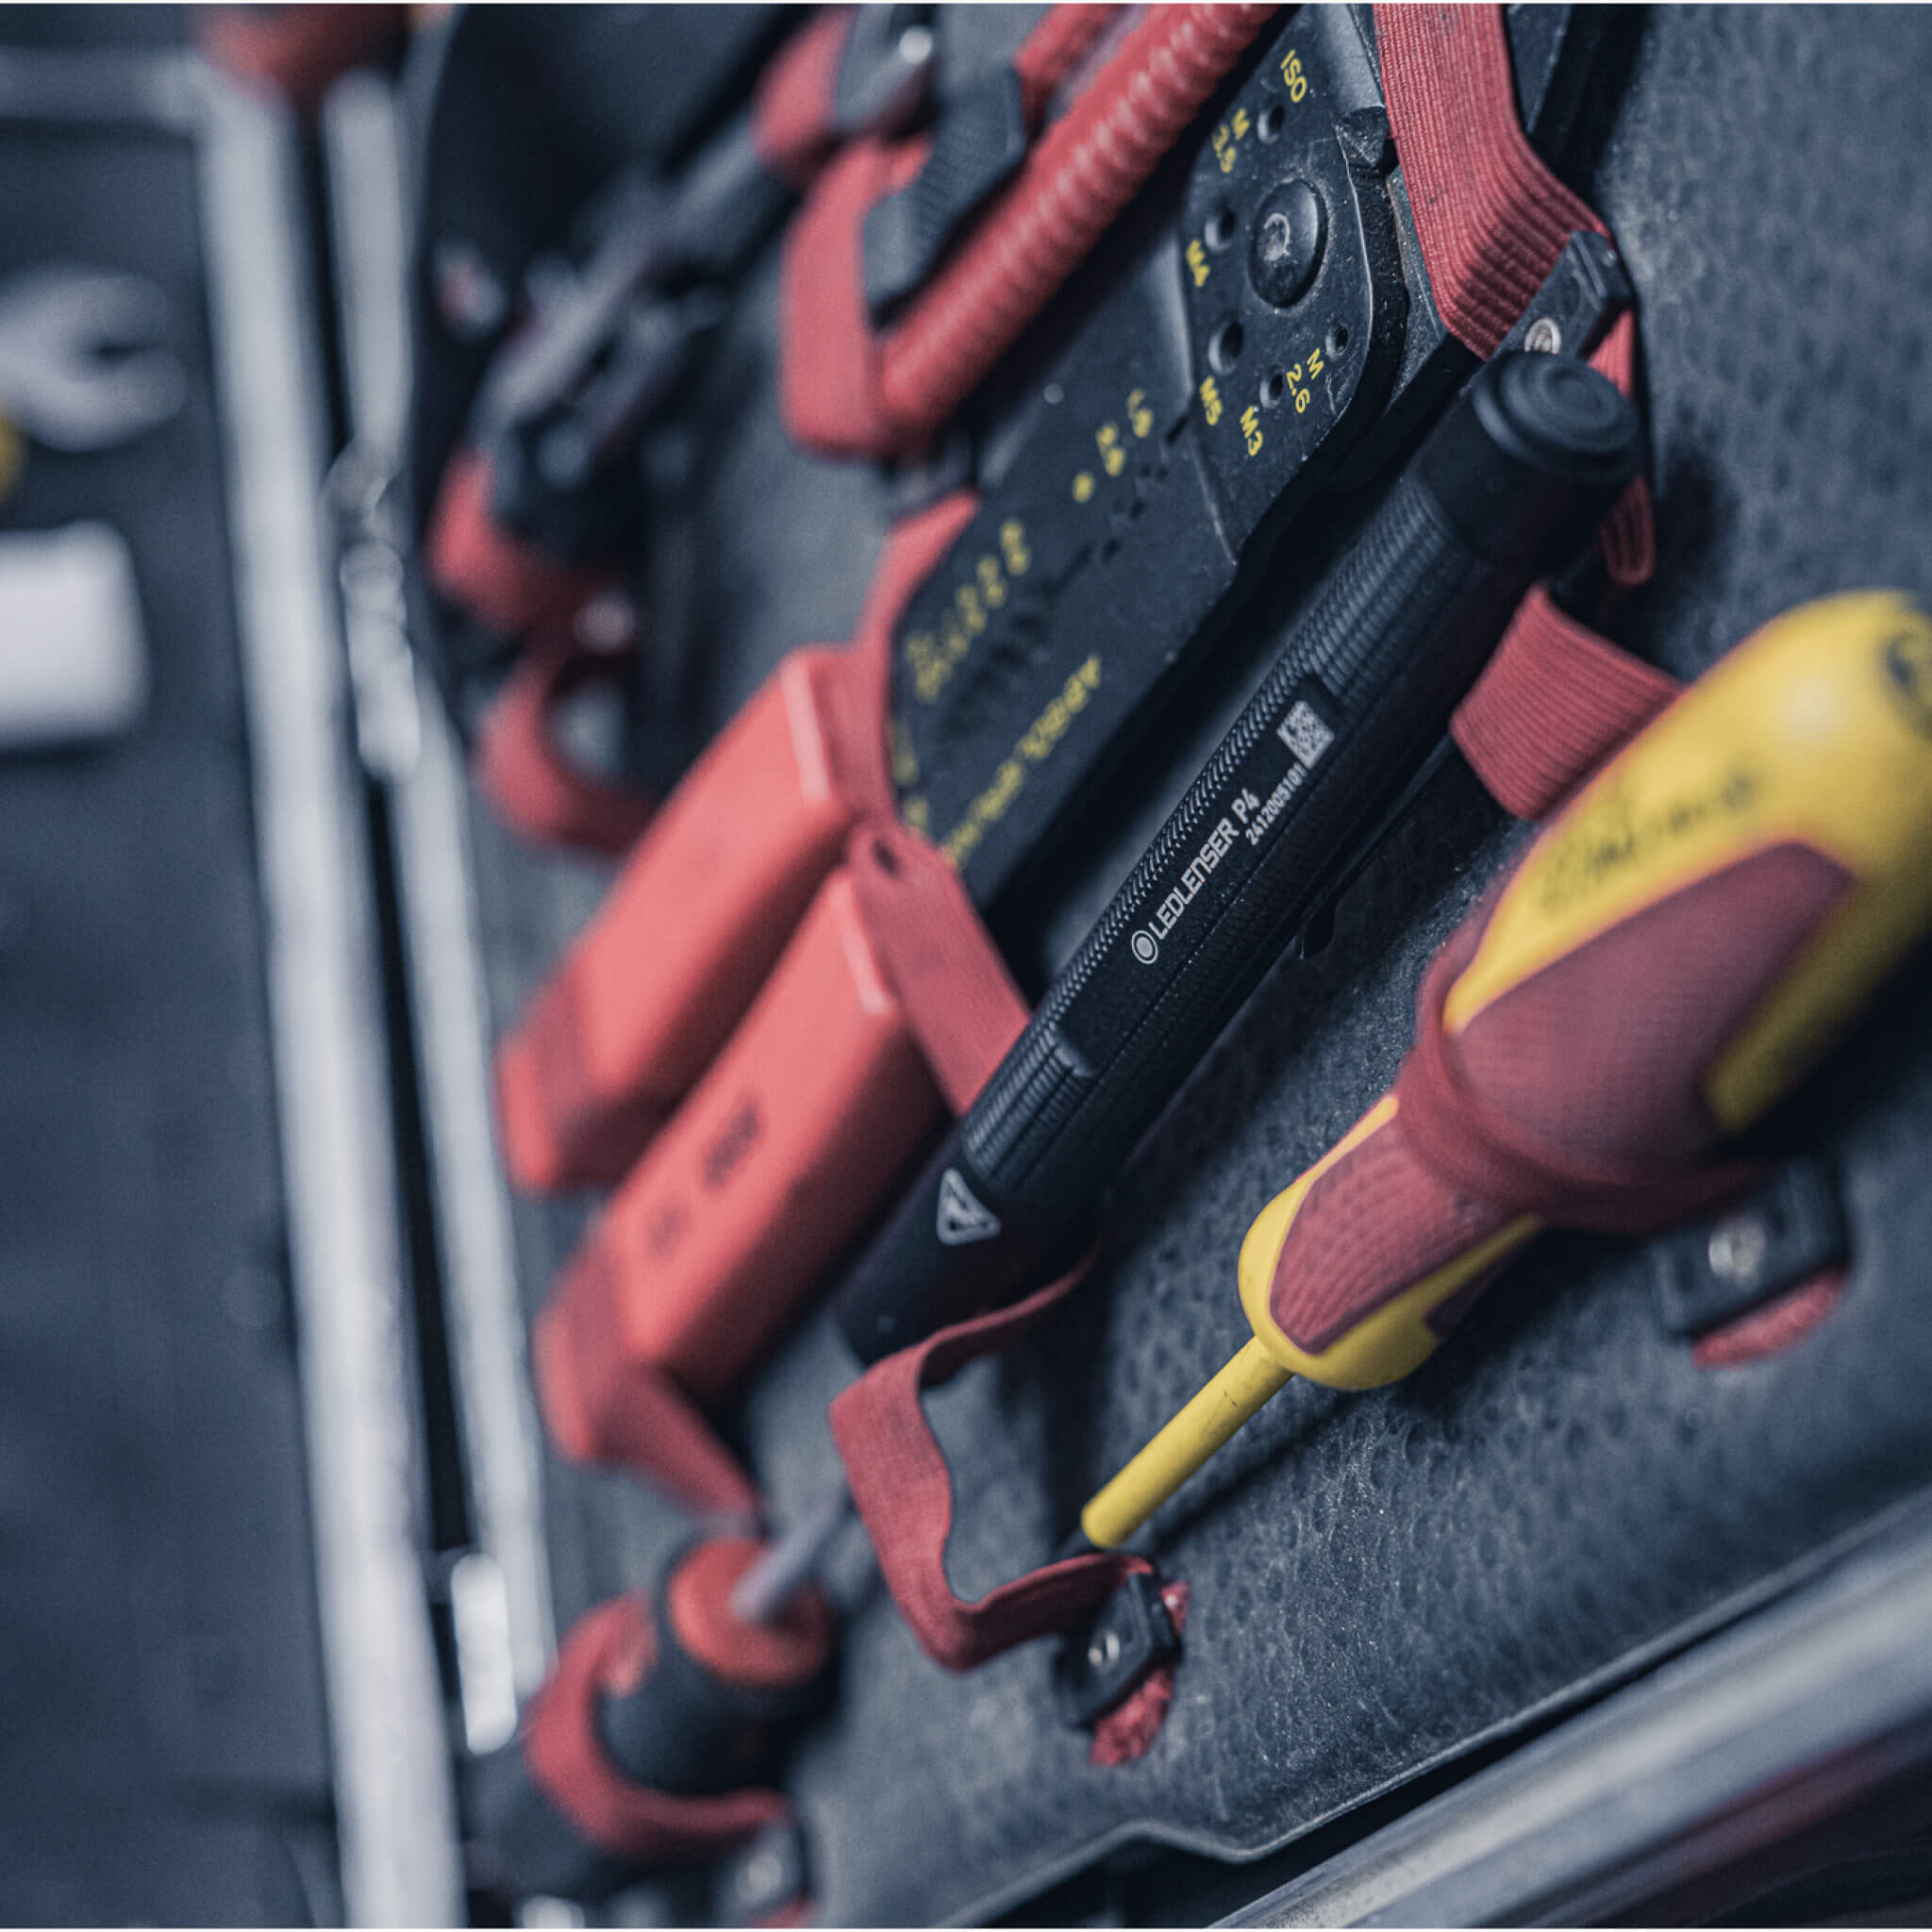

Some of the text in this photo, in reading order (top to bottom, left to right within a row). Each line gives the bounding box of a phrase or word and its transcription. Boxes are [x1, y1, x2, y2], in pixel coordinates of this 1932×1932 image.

[1280, 50, 1307, 103] ISO
[1232, 108, 1250, 140] M
[1186, 240, 1210, 287] M4
[1286, 363, 1311, 414] 2.6
[1305, 347, 1324, 380] M
[1240, 406, 1264, 457] M3
[1148, 788, 1260, 941] LEDLENSER P4
